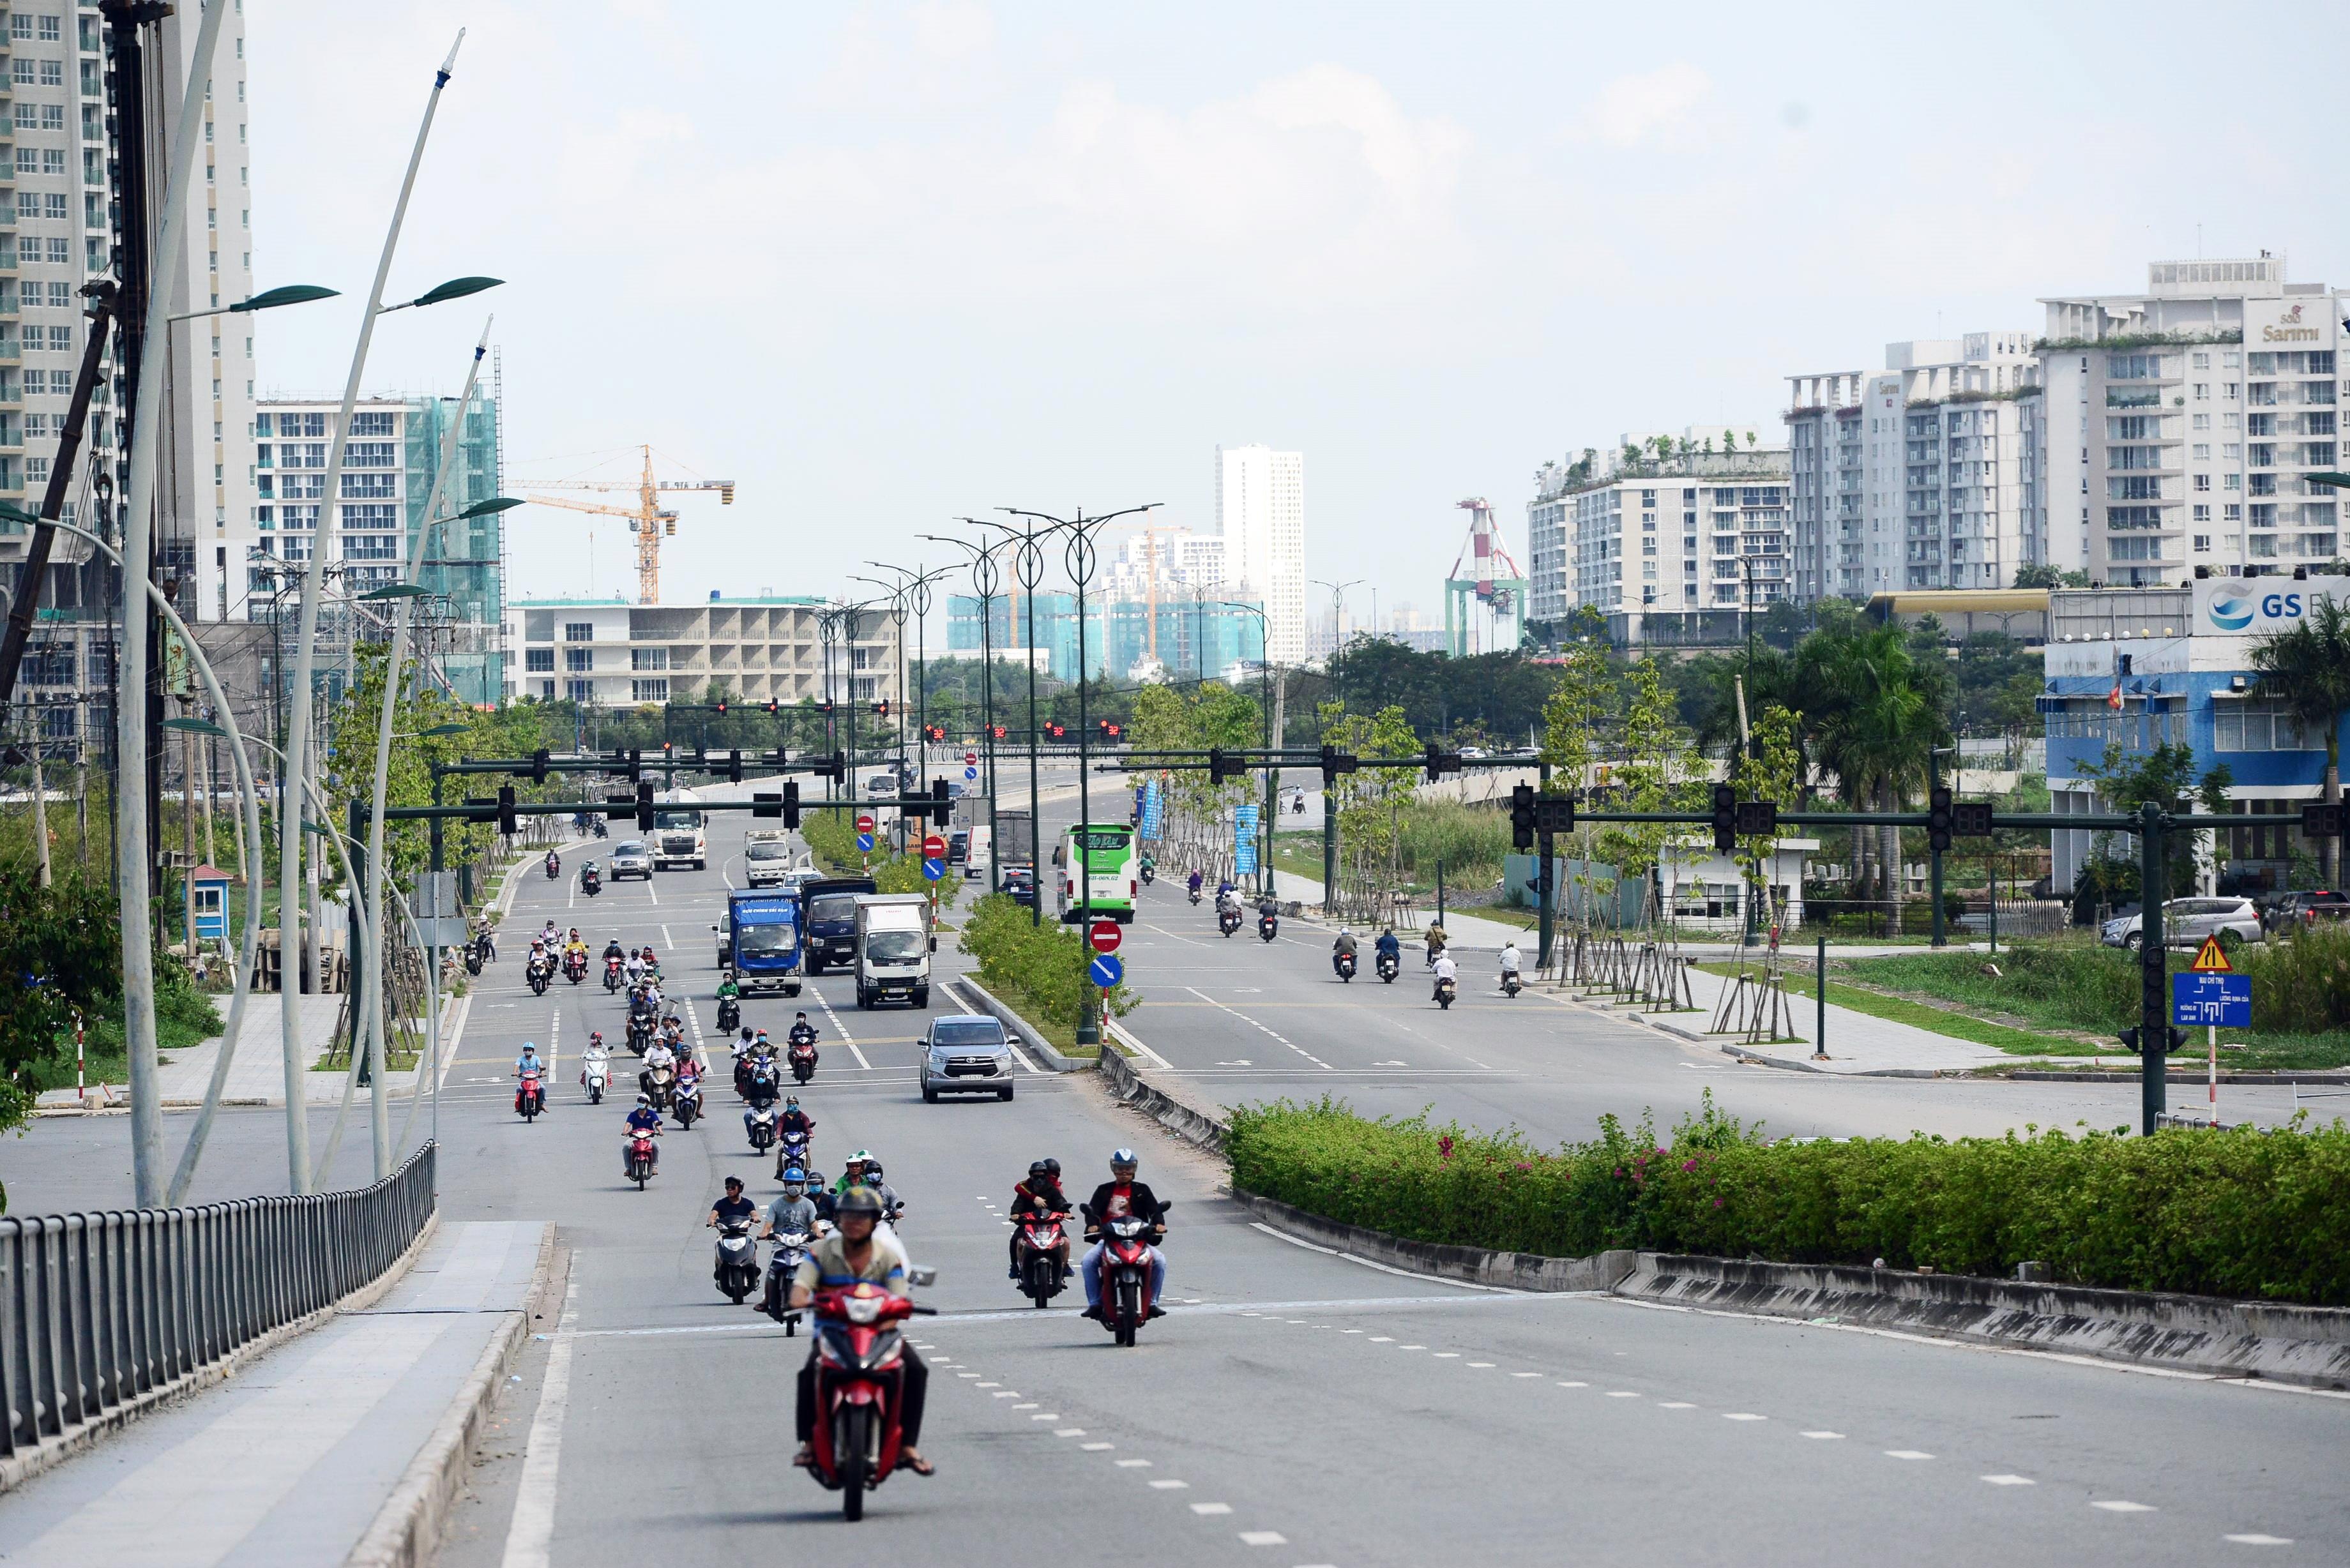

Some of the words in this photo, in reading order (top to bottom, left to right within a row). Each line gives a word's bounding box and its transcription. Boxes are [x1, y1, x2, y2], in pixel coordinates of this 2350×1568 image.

[2262, 594, 2301, 618] GS
[933, 728, 944, 739] 32
[994, 728, 1004, 737] 32
[1054, 727, 1064, 736] 32
[1108, 725, 1119, 735] 32
